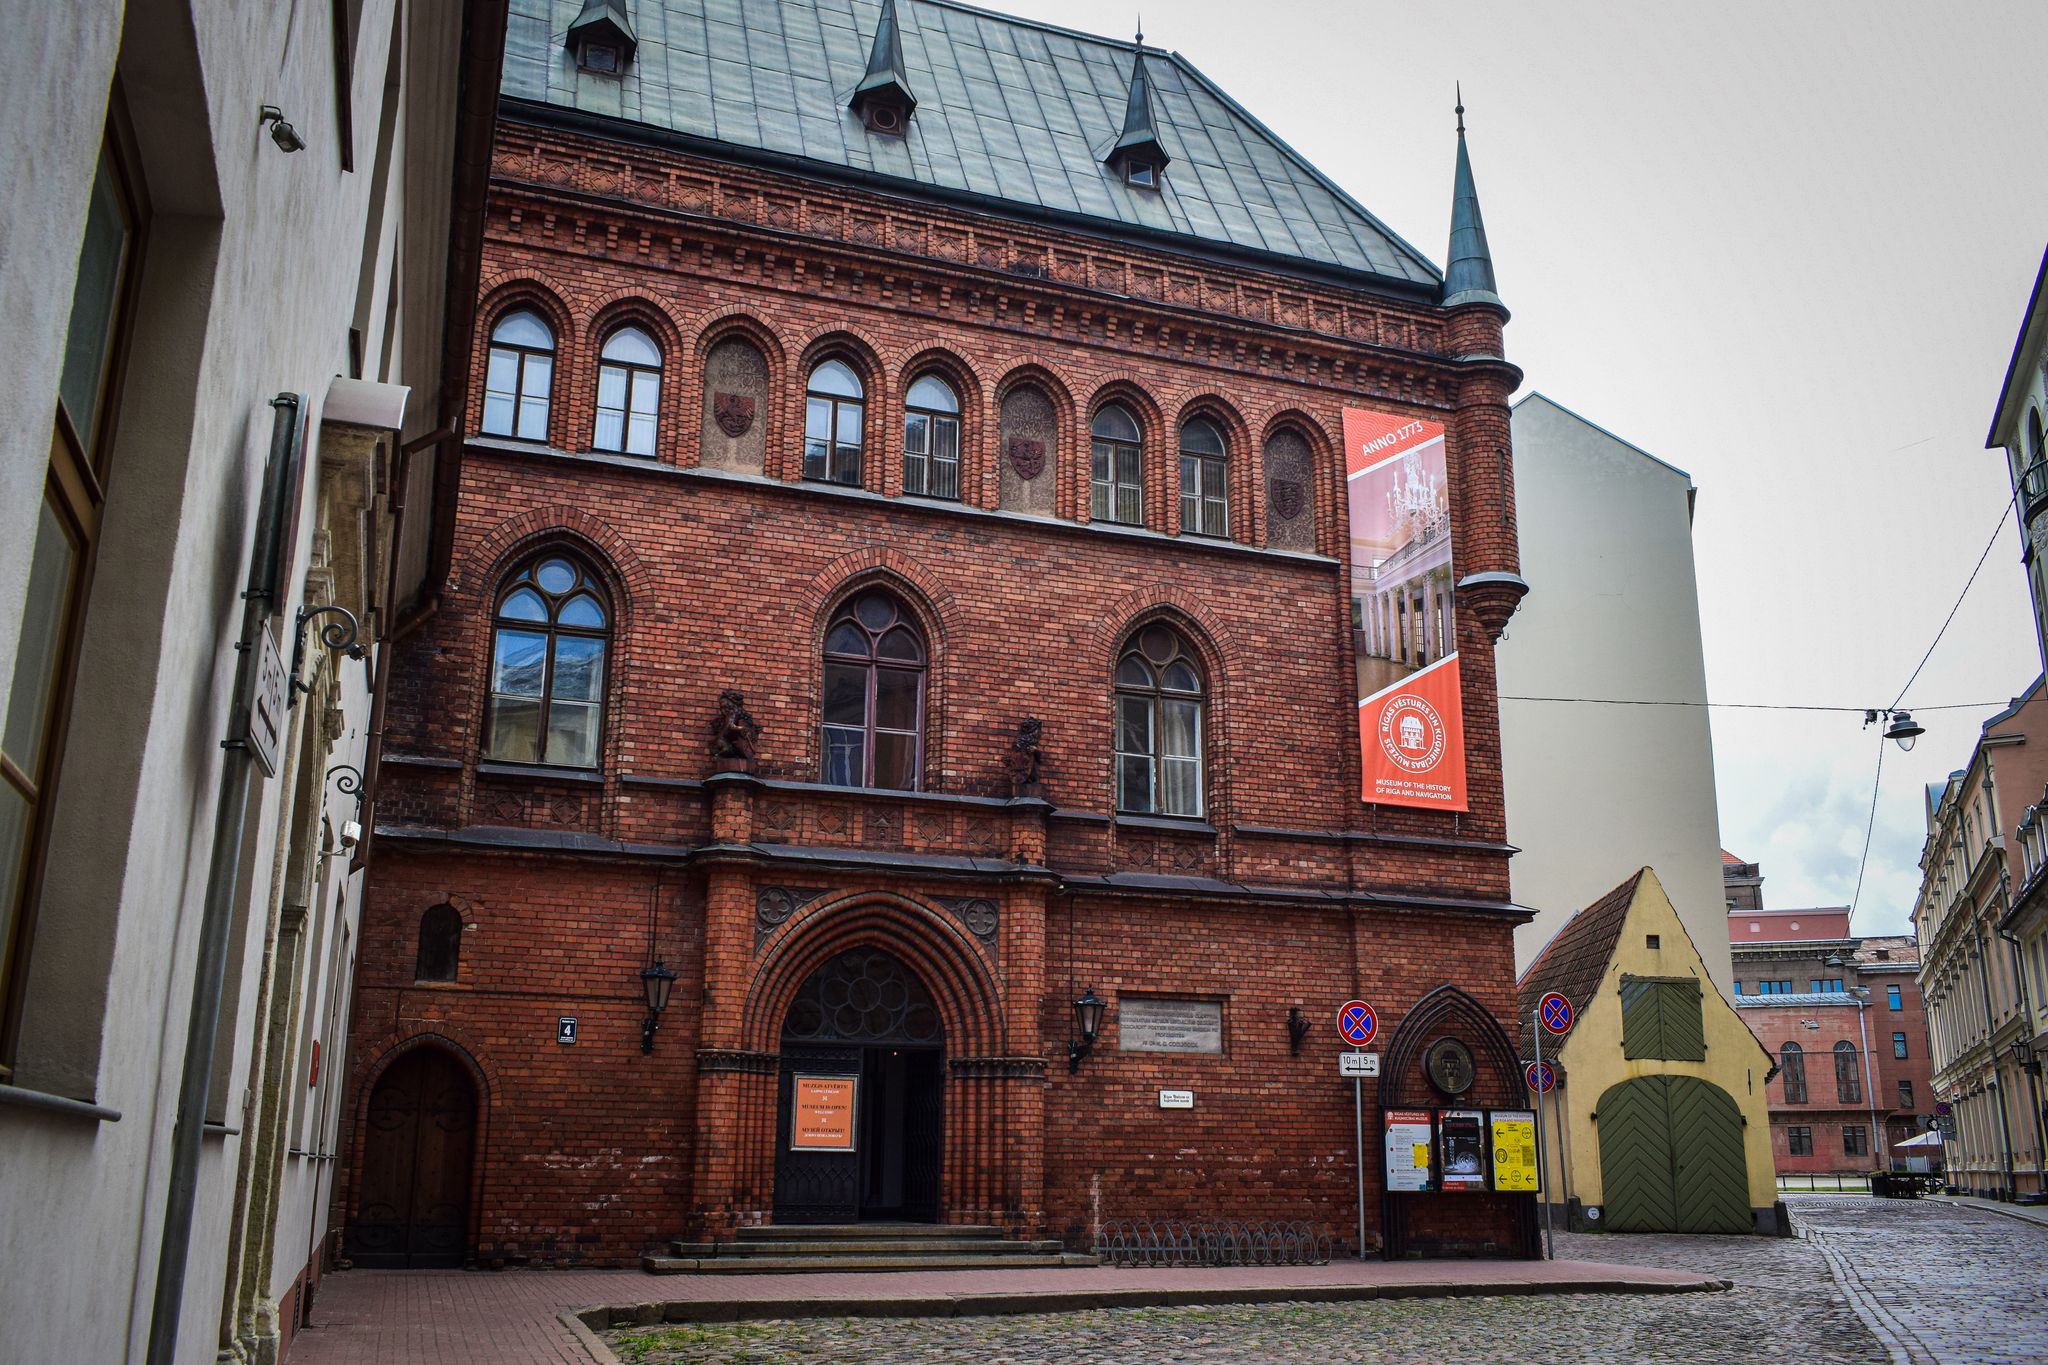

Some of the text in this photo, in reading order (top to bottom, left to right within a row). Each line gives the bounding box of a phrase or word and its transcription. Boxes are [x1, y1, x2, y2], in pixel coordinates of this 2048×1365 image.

[1362, 420, 1423, 456] ANNO 1773
[263, 644, 270, 682] 5
[273, 670, 279, 706] 5
[1393, 698, 1429, 714] VĒSTURES
[1382, 706, 1395, 732] RĪGAS
[1429, 713, 1439, 726] UN
[1384, 738, 1410, 767] MUZEJS
[1376, 779, 1402, 787] MUSEUM
[1426, 784, 1451, 792] HISTORY
[1415, 791, 1452, 800] NAVIGATION
[564, 1025, 571, 1035] 4
[1343, 1056, 1350, 1064] 10
